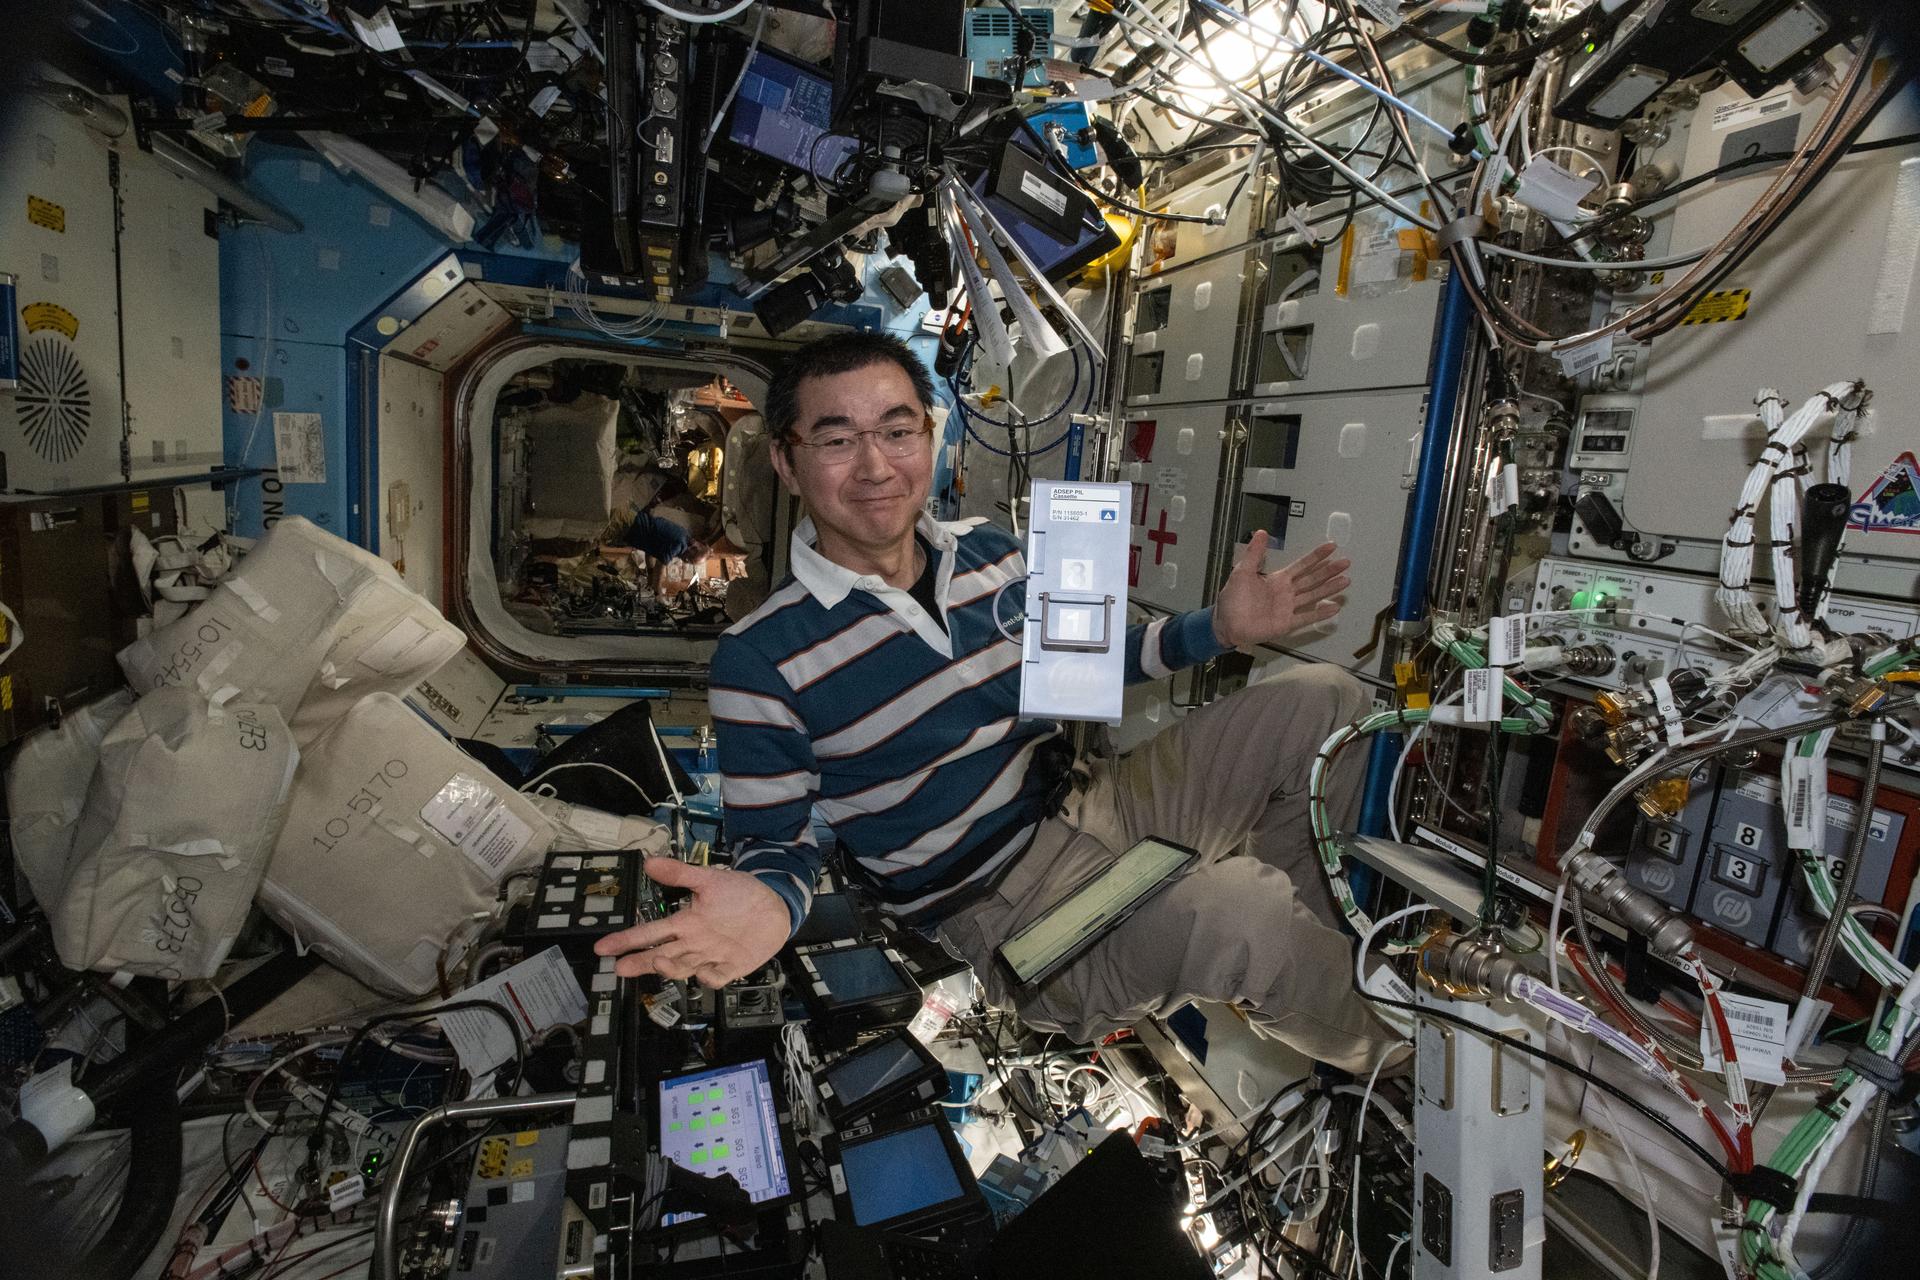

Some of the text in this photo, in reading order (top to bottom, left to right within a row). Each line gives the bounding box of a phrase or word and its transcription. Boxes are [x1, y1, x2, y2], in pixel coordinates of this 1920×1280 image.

[1828, 607, 1855, 617] APTOP
[1435, 837, 1452, 850] Module
[1658, 831, 1672, 850] 2
[1740, 826, 1756, 846] 8
[1731, 860, 1747, 879] 3
[1830, 859, 1846, 880] 8
[1683, 963, 1691, 971] D
